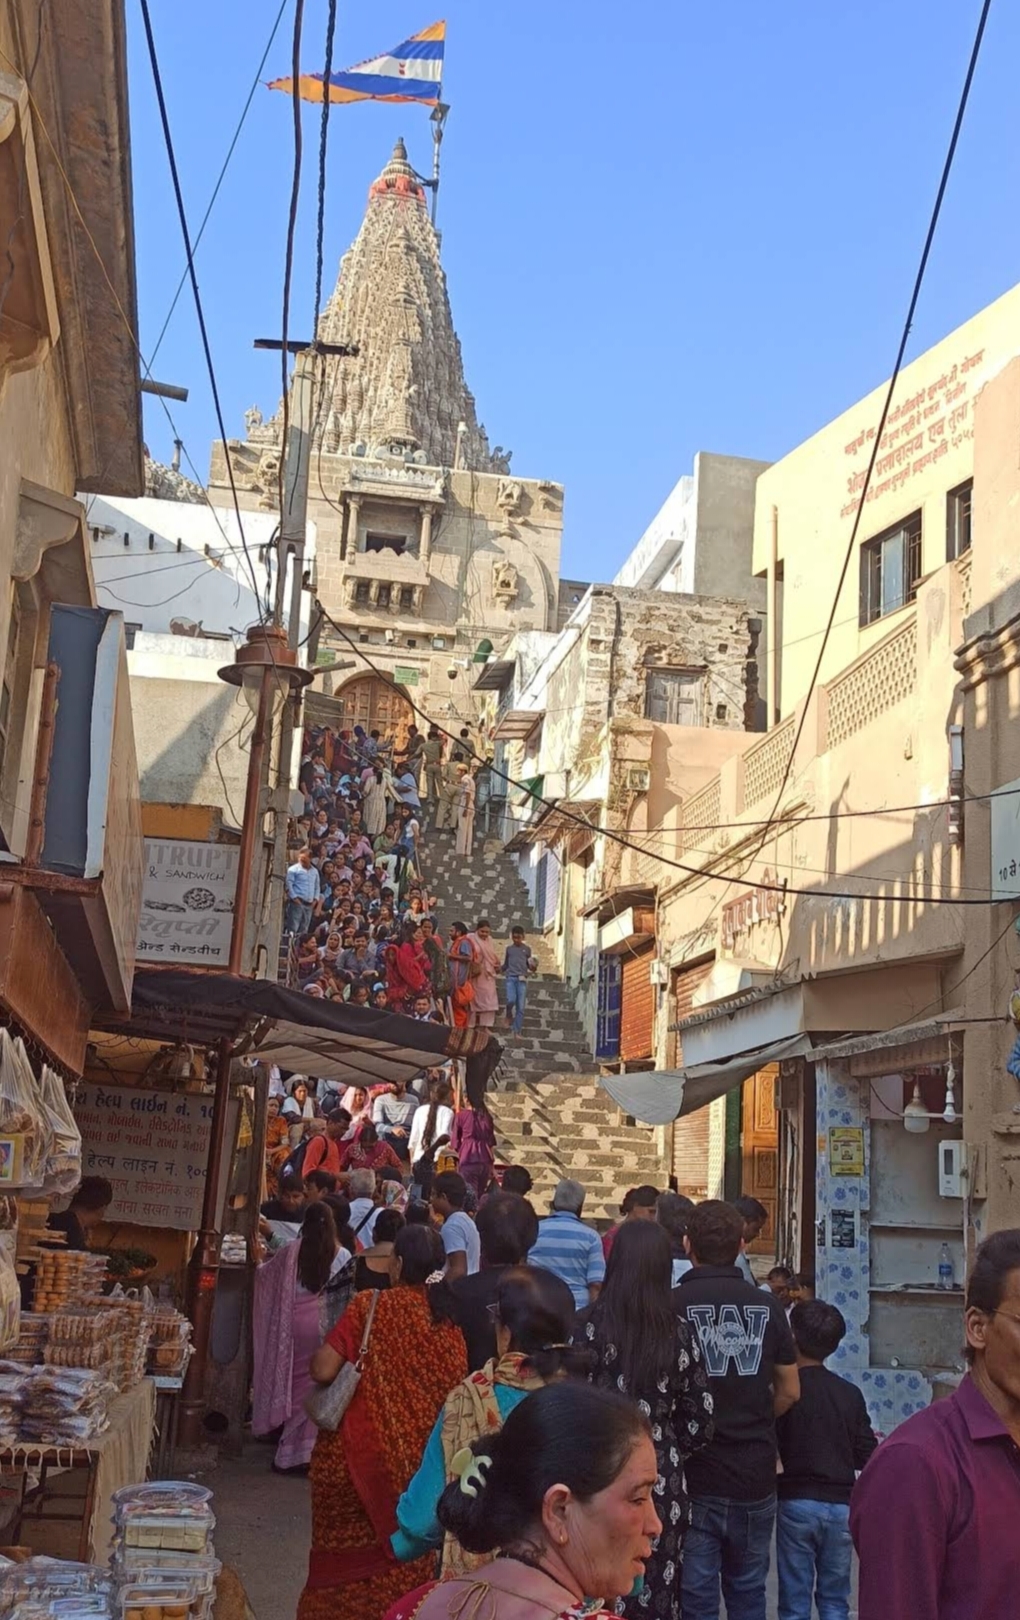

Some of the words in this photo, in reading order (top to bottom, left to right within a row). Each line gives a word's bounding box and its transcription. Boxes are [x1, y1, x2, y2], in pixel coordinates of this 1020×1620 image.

[145, 844, 238, 870] ITRUPT
[149, 865, 158, 879] &
[165, 869, 225, 881] SANDWICH
[999, 867, 1008, 881] 10
[87, 1149, 116, 1169] हेल्प
[122, 1157, 159, 1175] लाइन
